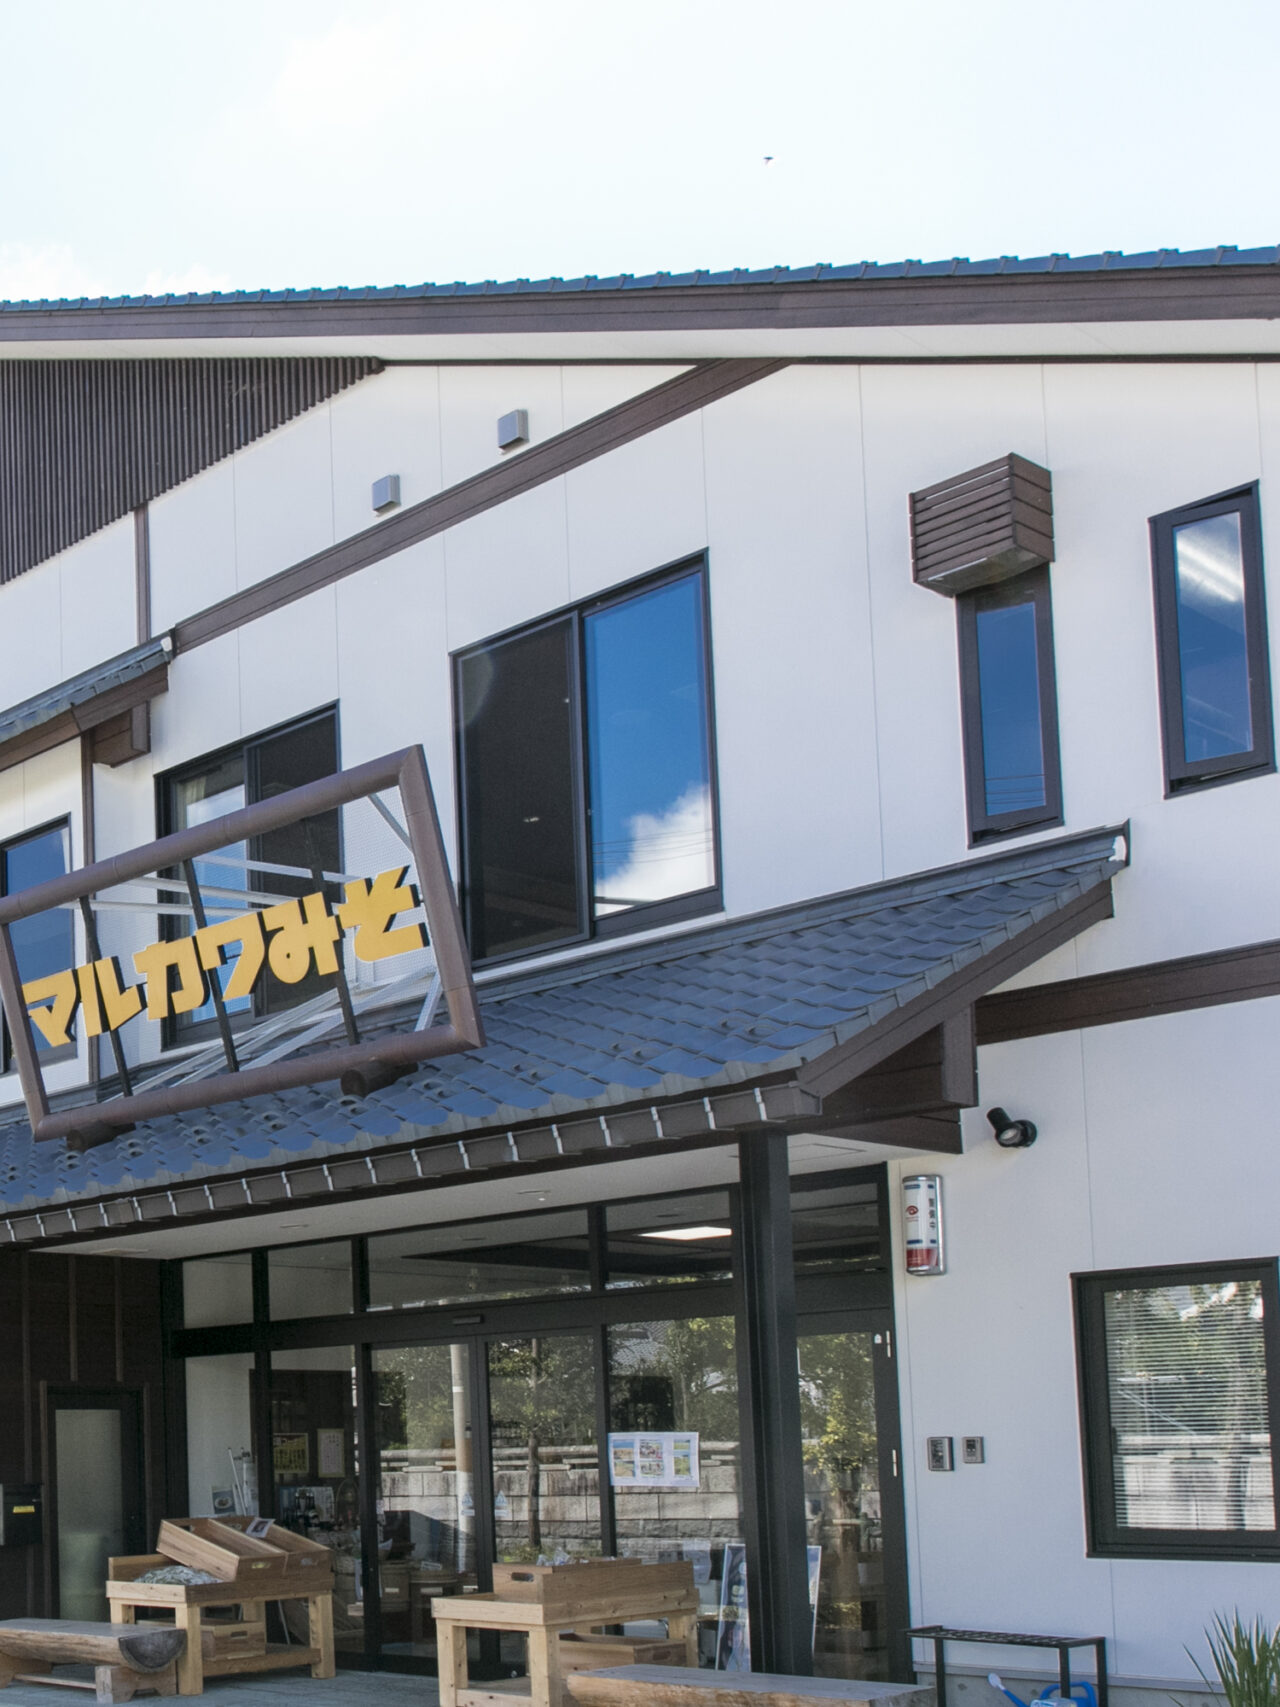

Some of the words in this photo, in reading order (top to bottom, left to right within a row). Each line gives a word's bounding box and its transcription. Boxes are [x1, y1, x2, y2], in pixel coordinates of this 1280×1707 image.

[22, 865, 430, 1047] マルカワみそ
